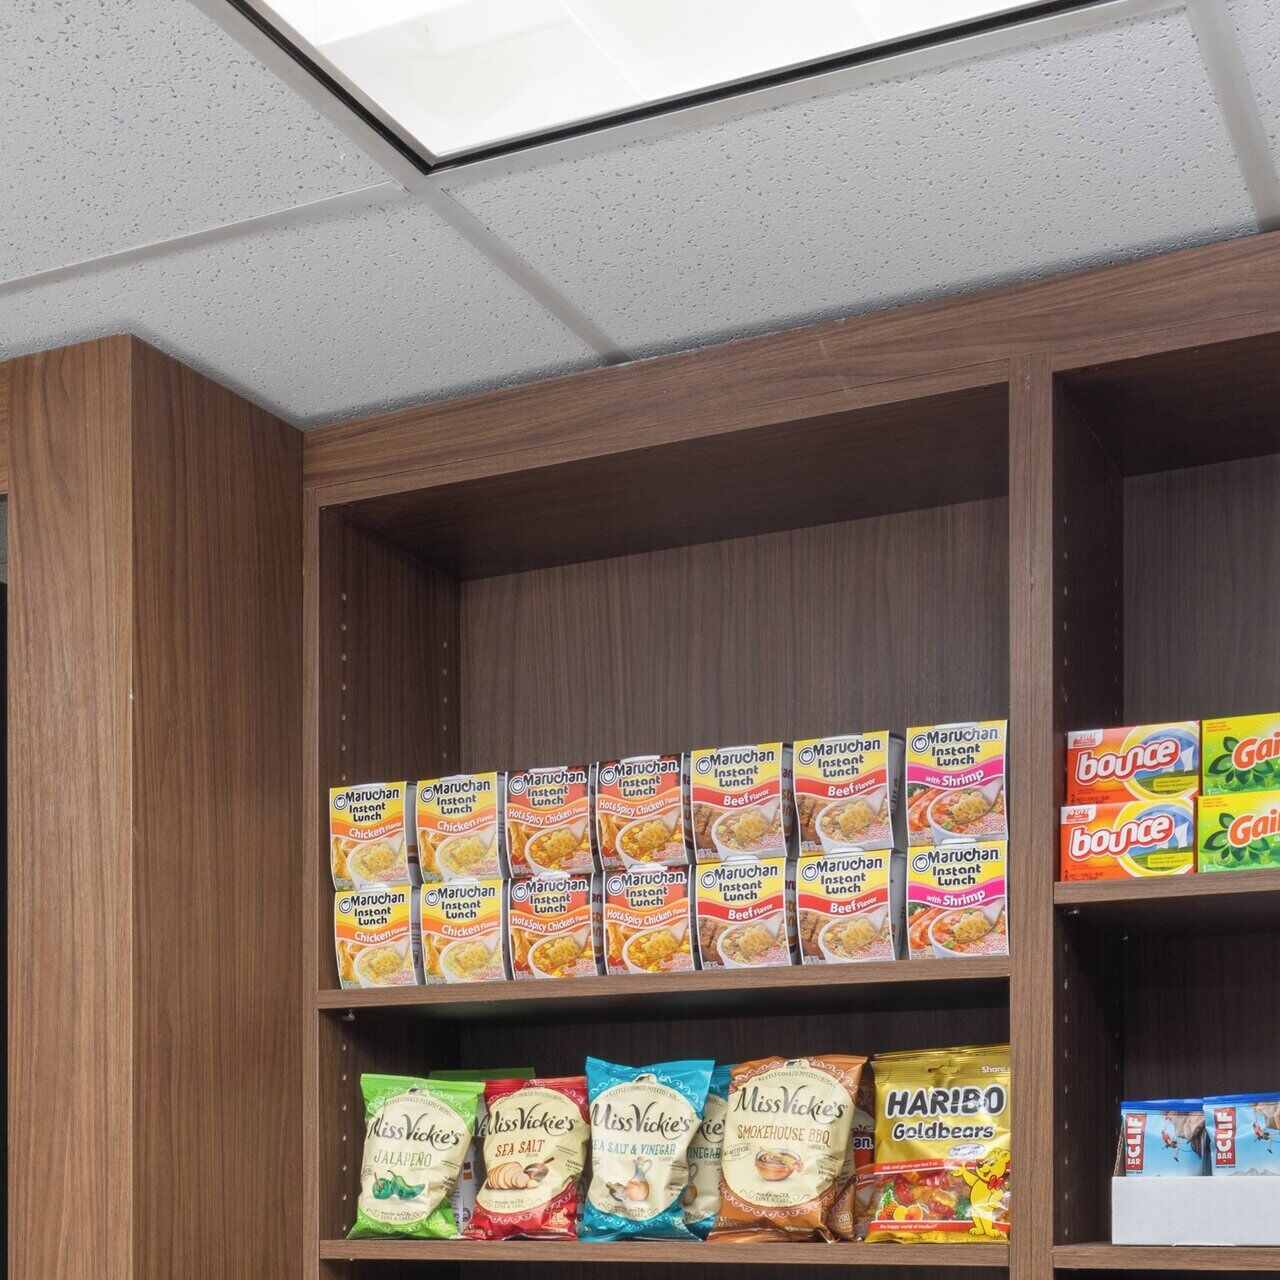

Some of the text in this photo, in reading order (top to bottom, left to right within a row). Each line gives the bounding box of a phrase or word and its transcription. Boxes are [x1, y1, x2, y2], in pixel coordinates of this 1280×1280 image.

[928, 727, 999, 745] Maruchan
[813, 739, 881, 756] Maruchan
[931, 744, 980, 756] Instant
[711, 750, 775, 765] Maruchan
[937, 755, 975, 766] Lunch
[1077, 739, 1179, 781] bounce
[614, 760, 677, 776] Maruchan
[523, 771, 584, 787] Maruchan
[925, 770, 984, 787] with Shrimp
[345, 787, 400, 803] Maruchan
[433, 780, 491, 795] Maruchan
[828, 785, 854, 797] Beef
[349, 803, 386, 813] Instant
[437, 795, 477, 806] Instant
[723, 795, 748, 806] Beef
[353, 812, 382, 822] Lunch
[441, 804, 472, 814] Lunch
[349, 825, 385, 838] Chicken
[437, 819, 476, 831] Chicken
[1071, 815, 1173, 857] bounce
[928, 848, 1000, 865] Maruchan
[715, 865, 779, 880] Maruchan
[526, 880, 586, 894] Maruchan
[350, 893, 405, 906] Maruchan
[733, 1085, 844, 1123] Miss Vickie's
[887, 1087, 1004, 1117] HARIBO
[518, 1103, 575, 1136] Vickie's
[590, 1101, 692, 1139] Miss Vickie's
[402, 1114, 460, 1151] Vickie's
[737, 1124, 831, 1147] SMOKEHOUSE BBQ
[893, 1122, 994, 1139] Goldbears
[1125, 1115, 1145, 1157] CLIF
[495, 1139, 545, 1157] SEA SALT
[608, 1143, 629, 1154] SALT
[631, 1145, 637, 1155] &
[641, 1144, 676, 1155] VINEGAR
[1127, 1158, 1141, 1166] BAR
